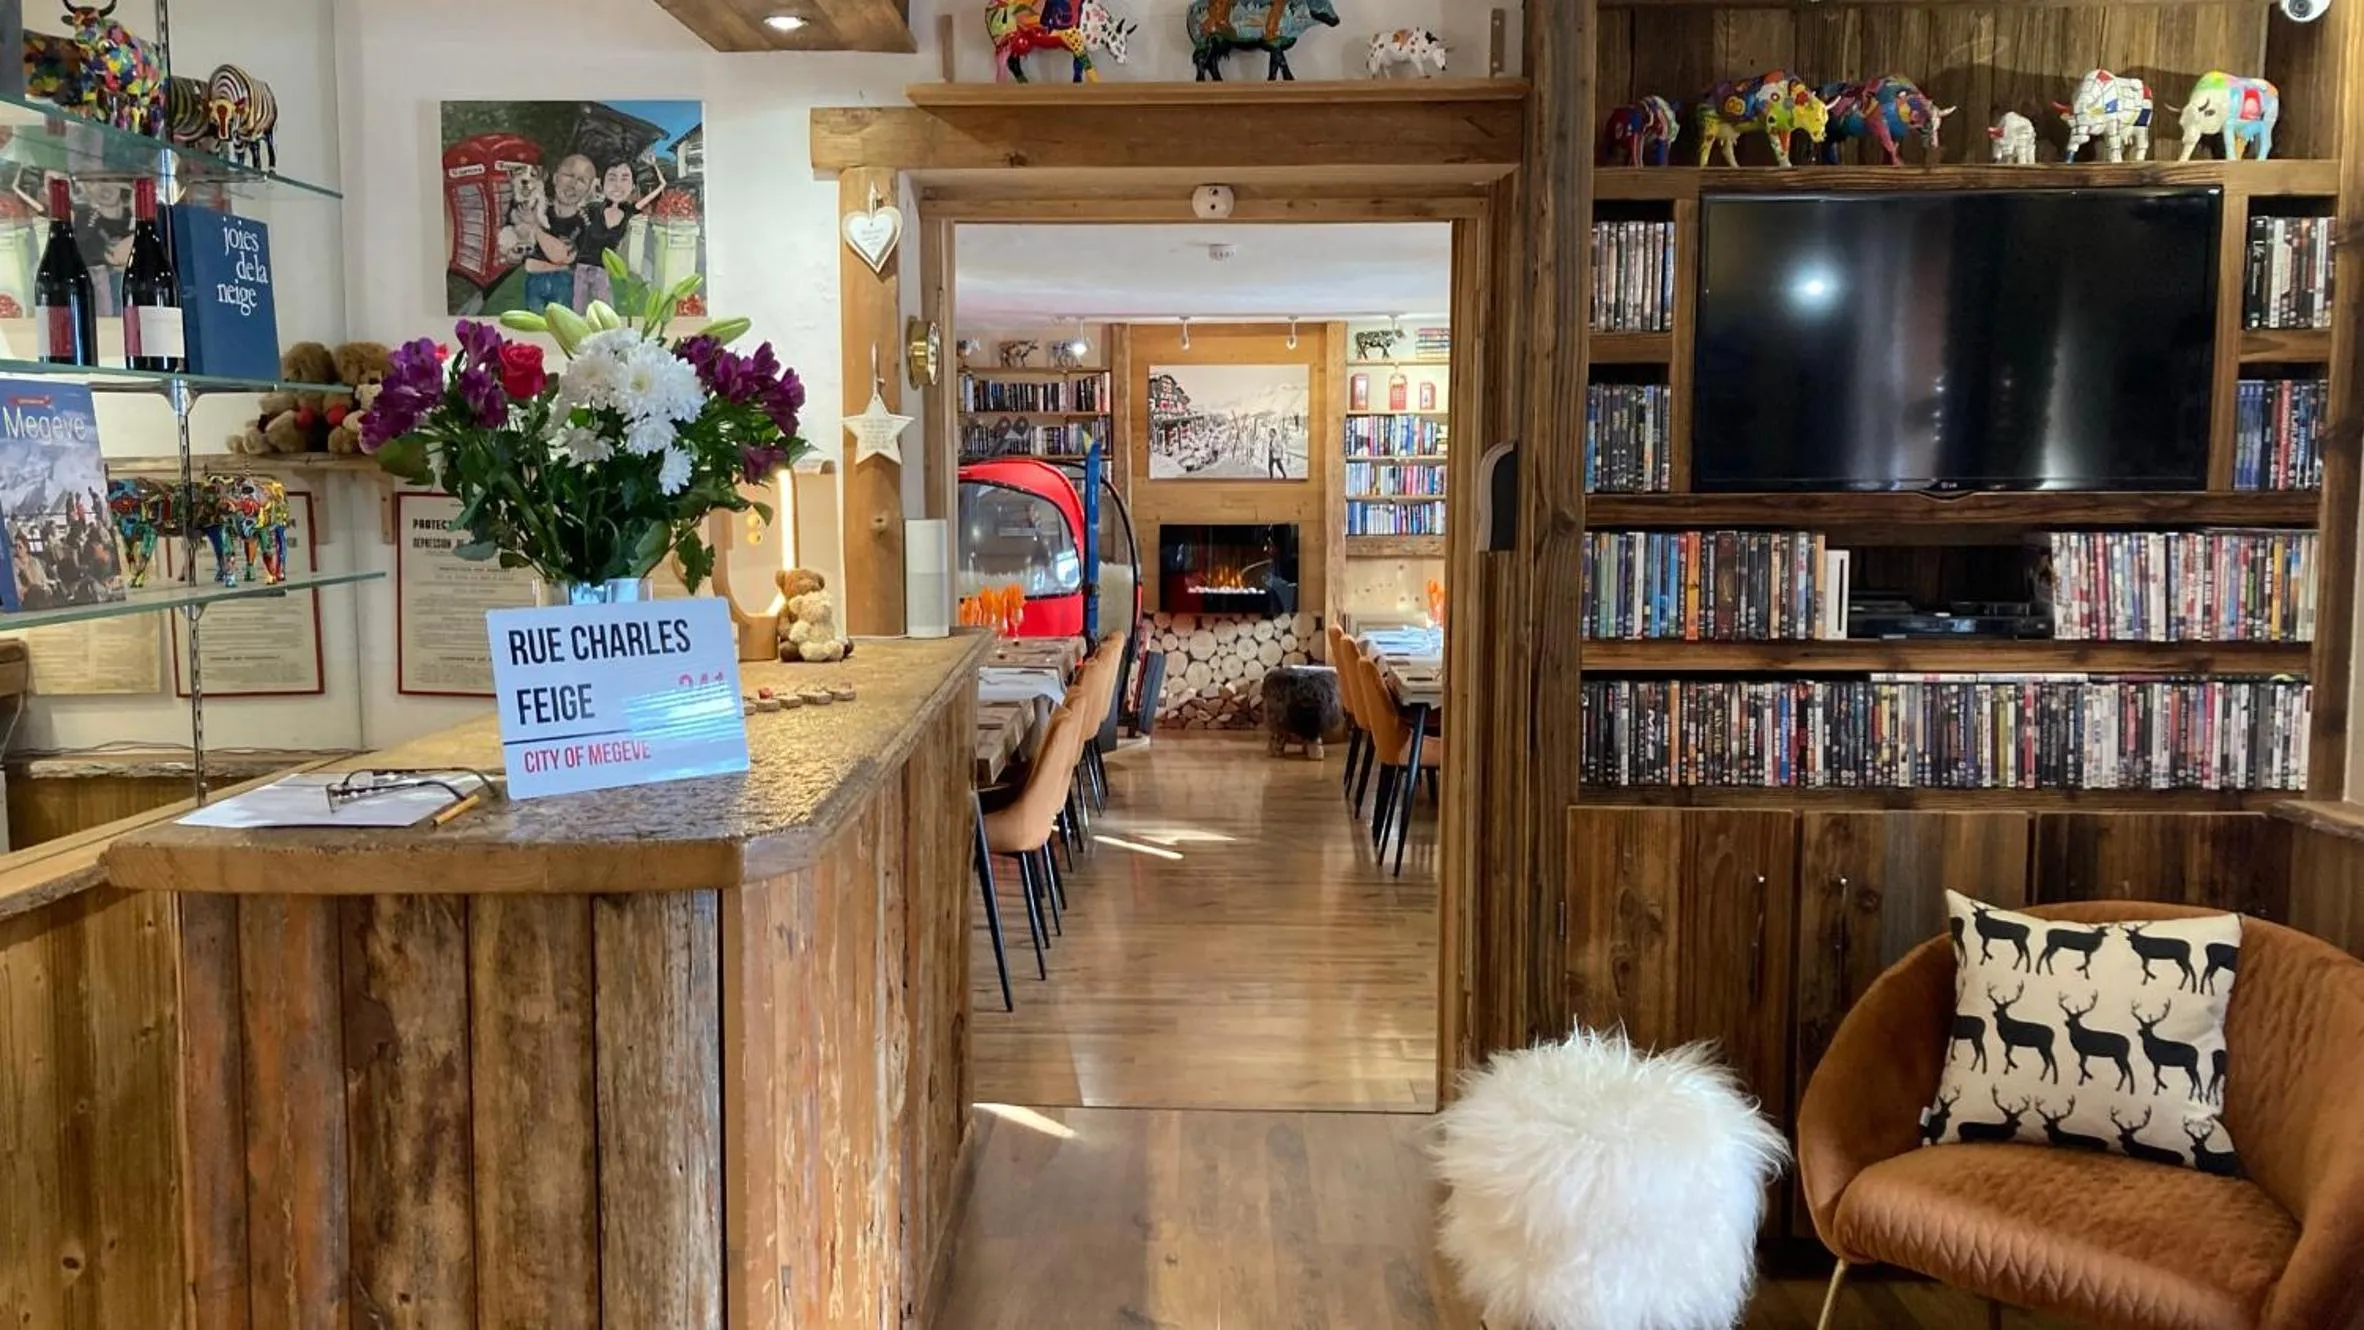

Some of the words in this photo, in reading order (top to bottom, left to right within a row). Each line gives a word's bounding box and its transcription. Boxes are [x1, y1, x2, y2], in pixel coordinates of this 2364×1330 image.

[223, 216, 259, 256] joies
[217, 279, 257, 316] neige
[508, 627, 565, 665] RUE
[571, 618, 691, 660] CHARLES
[516, 684, 595, 725] FEIGE
[524, 744, 560, 773] CITY
[564, 746, 585, 768] OF
[588, 740, 651, 765] MEGEVE
